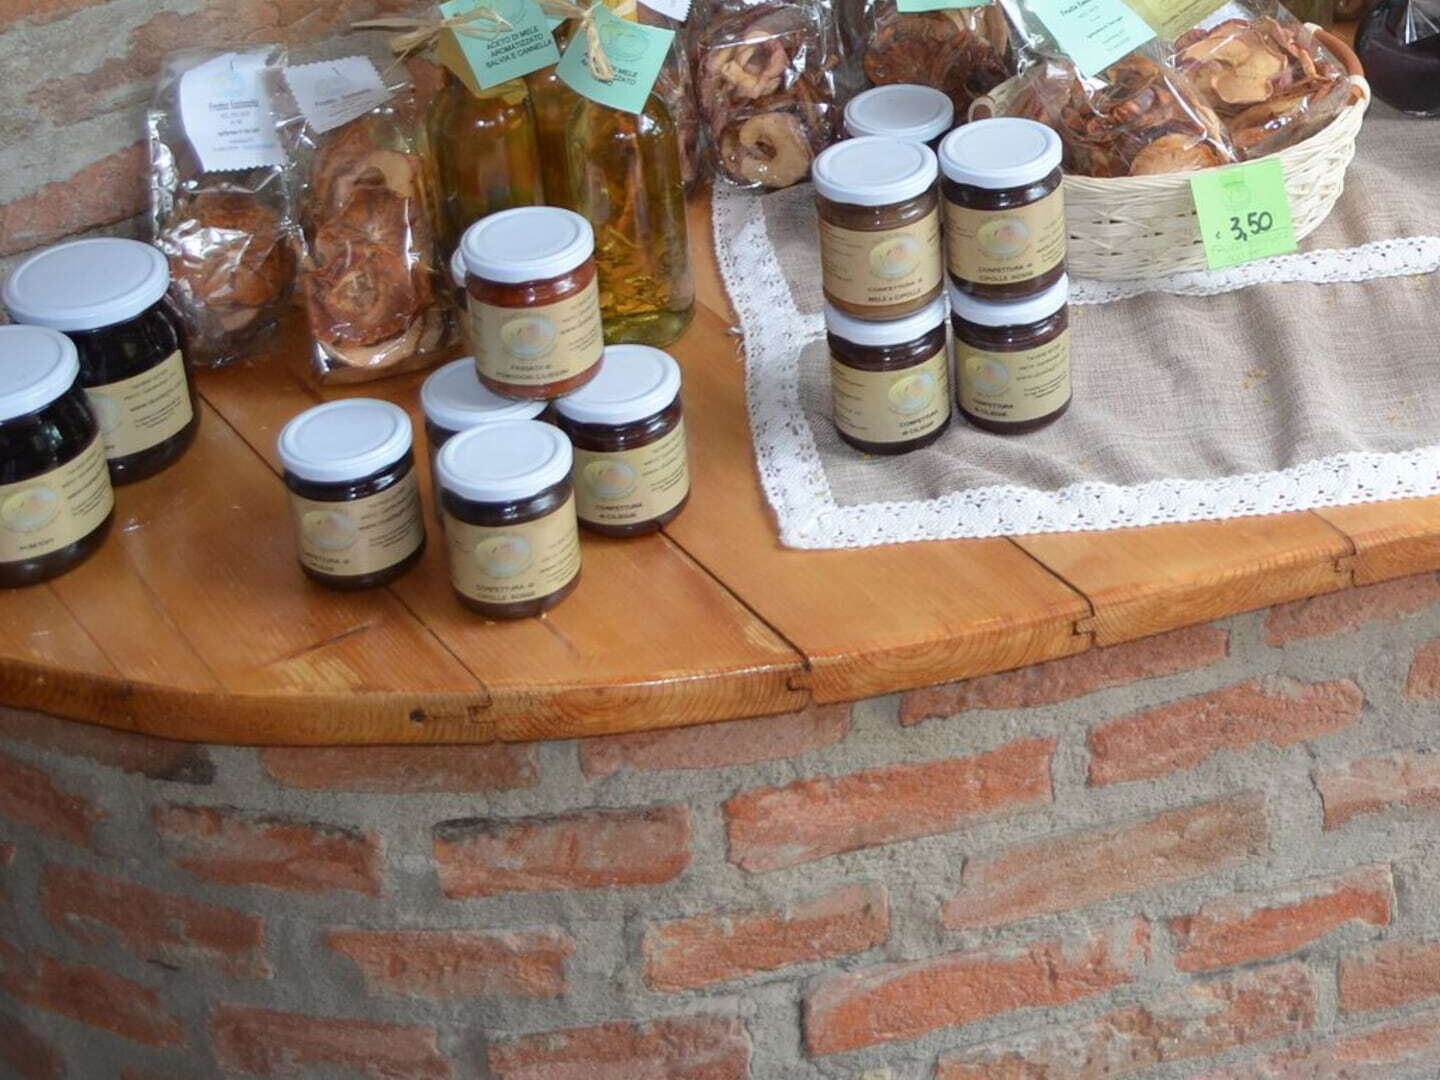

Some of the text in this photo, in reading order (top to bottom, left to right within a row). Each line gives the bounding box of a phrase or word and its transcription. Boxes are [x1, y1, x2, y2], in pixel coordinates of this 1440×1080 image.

[485, 36, 510, 50] ACETO
[520, 25, 538, 37] MELE
[490, 34, 544, 57] AROMATIZZATO
[486, 52, 510, 68] SALVIA
[517, 39, 552, 57] CANNELLA
[1230, 211, 1273, 241] 3,50
